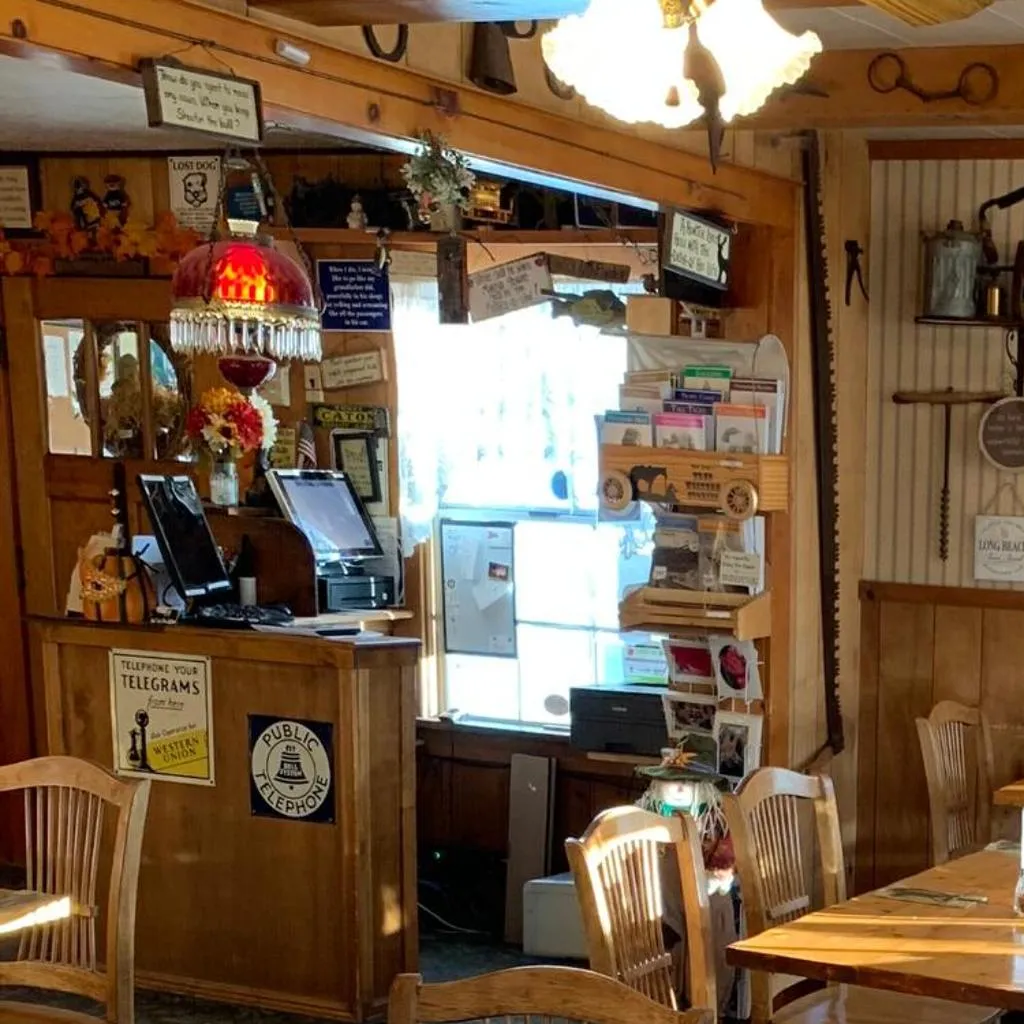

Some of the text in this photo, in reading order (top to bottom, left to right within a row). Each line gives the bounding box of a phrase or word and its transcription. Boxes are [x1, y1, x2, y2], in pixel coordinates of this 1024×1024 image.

[173, 161, 216, 171] LOST DOG
[979, 539, 1001, 552] LONG
[121, 660, 200, 675] TELEPHONE YOUR
[120, 673, 201, 695] TELEGRAMS
[147, 694, 185, 712] from here
[152, 737, 199, 755] WESTERN
[262, 723, 319, 752] PUBLIC
[163, 747, 197, 763] UNION
[255, 769, 329, 814] TELEPHONE
